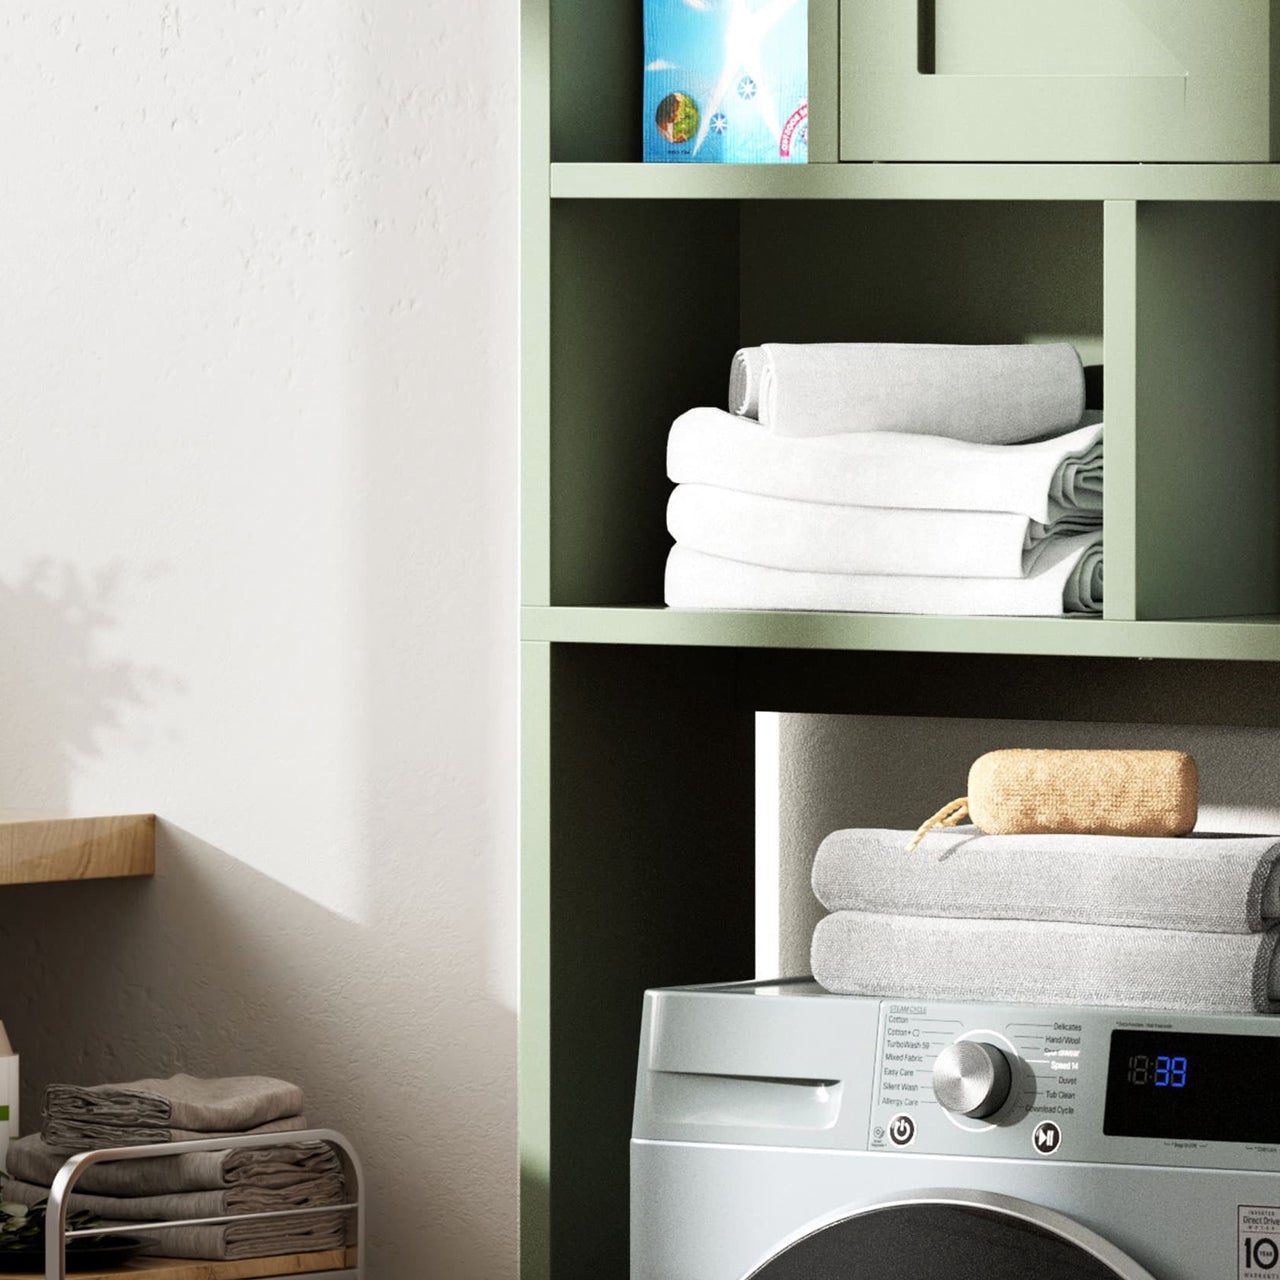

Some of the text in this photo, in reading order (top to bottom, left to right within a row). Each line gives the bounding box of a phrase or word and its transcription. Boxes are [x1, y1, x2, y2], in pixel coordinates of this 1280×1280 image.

[888, 1016, 908, 1024] Cotton
[1054, 1022, 1082, 1031] Delicates
[886, 1053, 923, 1062] Mixed Fabric
[884, 1068, 914, 1078] Easy Care
[1058, 1076, 1077, 1085] Duvet
[882, 1082, 900, 1090] Silent
[1046, 1090, 1076, 1100] Tub Clean
[881, 1097, 918, 1106] Allergy Care
[1057, 1106, 1074, 1116] Cycle
[1242, 1216, 1280, 1226] Direct Drive
[1244, 1238, 1279, 1270] 10
